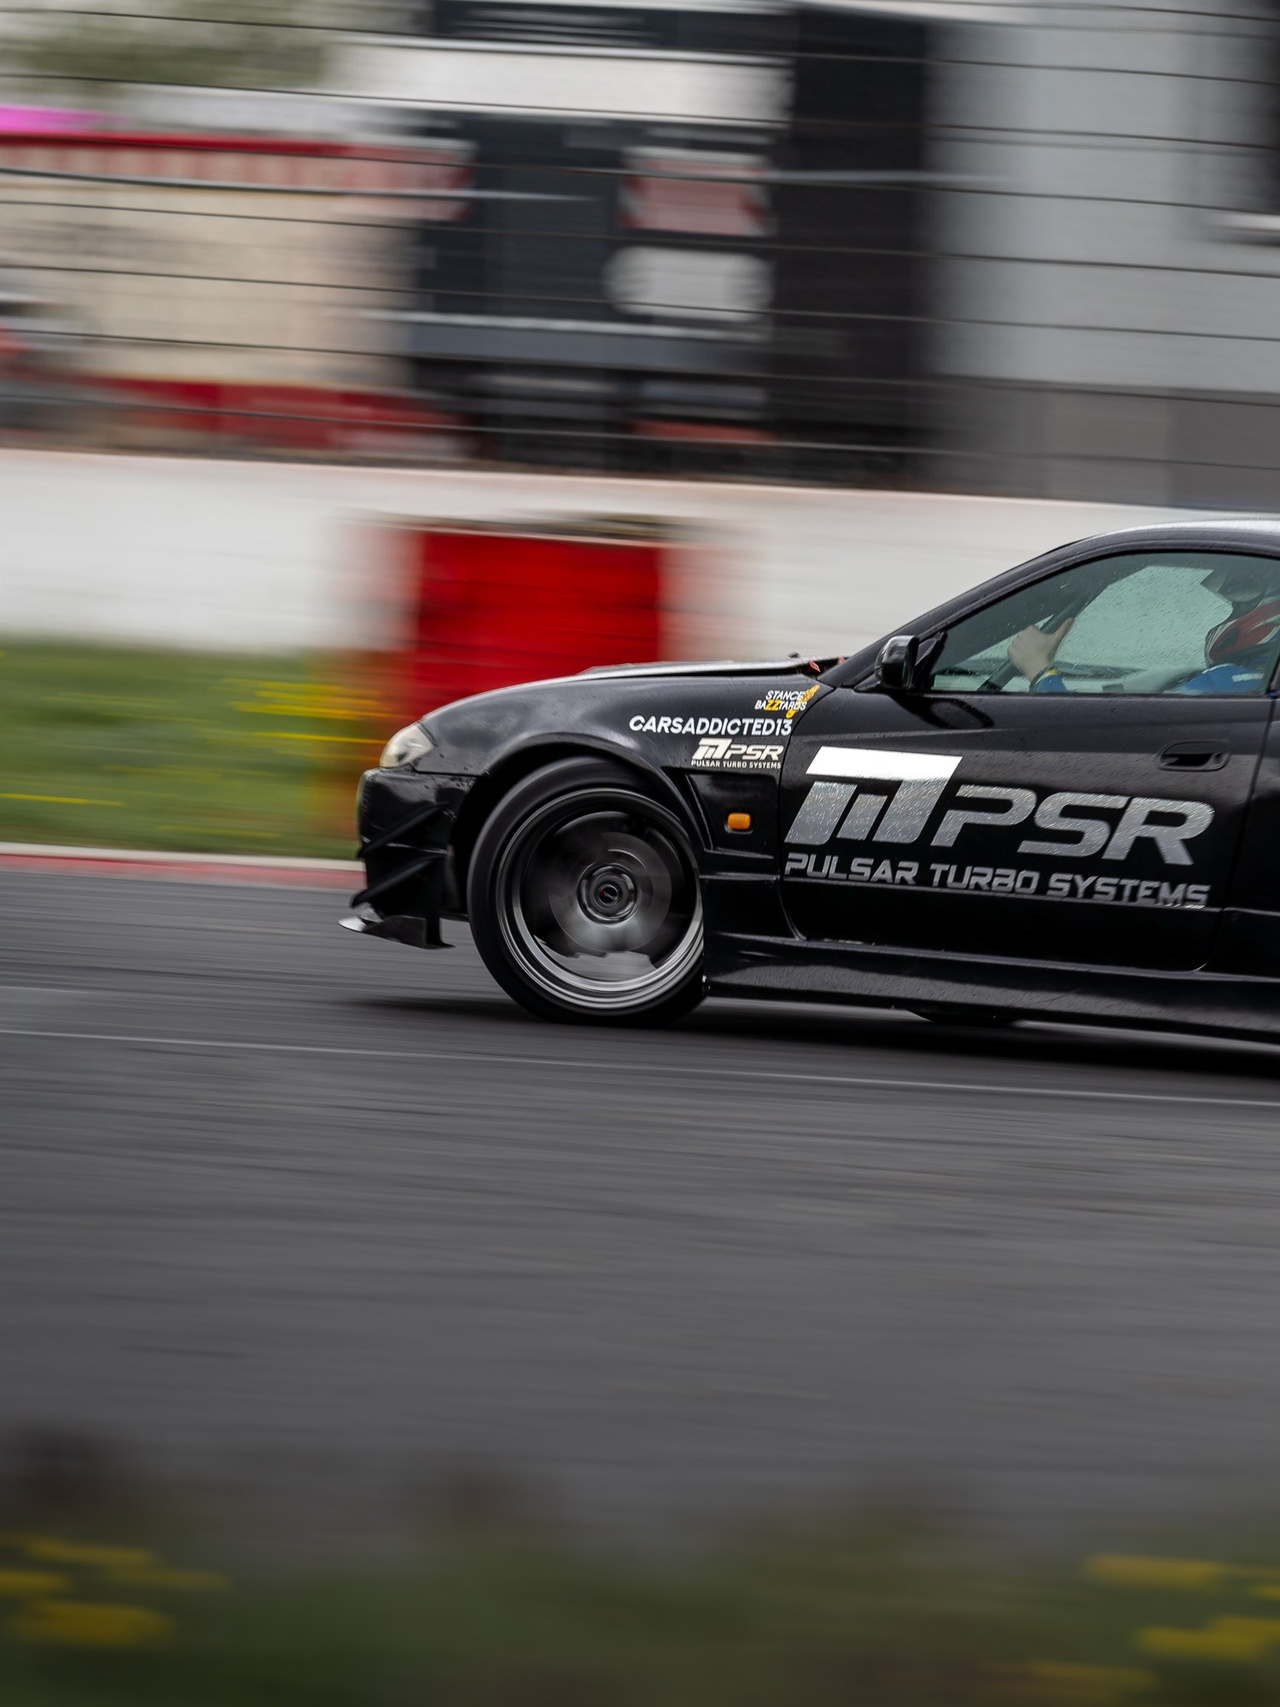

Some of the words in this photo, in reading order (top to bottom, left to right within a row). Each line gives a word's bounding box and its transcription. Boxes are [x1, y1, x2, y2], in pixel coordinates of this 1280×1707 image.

[766, 690, 804, 700] STANCE
[754, 700, 807, 711] BAZZTARDS
[629, 715, 793, 736] CARSADDICTED13
[724, 744, 784, 760] PSR
[691, 759, 721, 768] PULSAR
[722, 760, 747, 769] TURBO
[749, 761, 781, 769] SYSTEMS
[930, 784, 1215, 866] PSR
[783, 852, 917, 885] PULSAR
[929, 863, 1040, 895] TURBO
[1047, 872, 1211, 909] SYSTEMS
